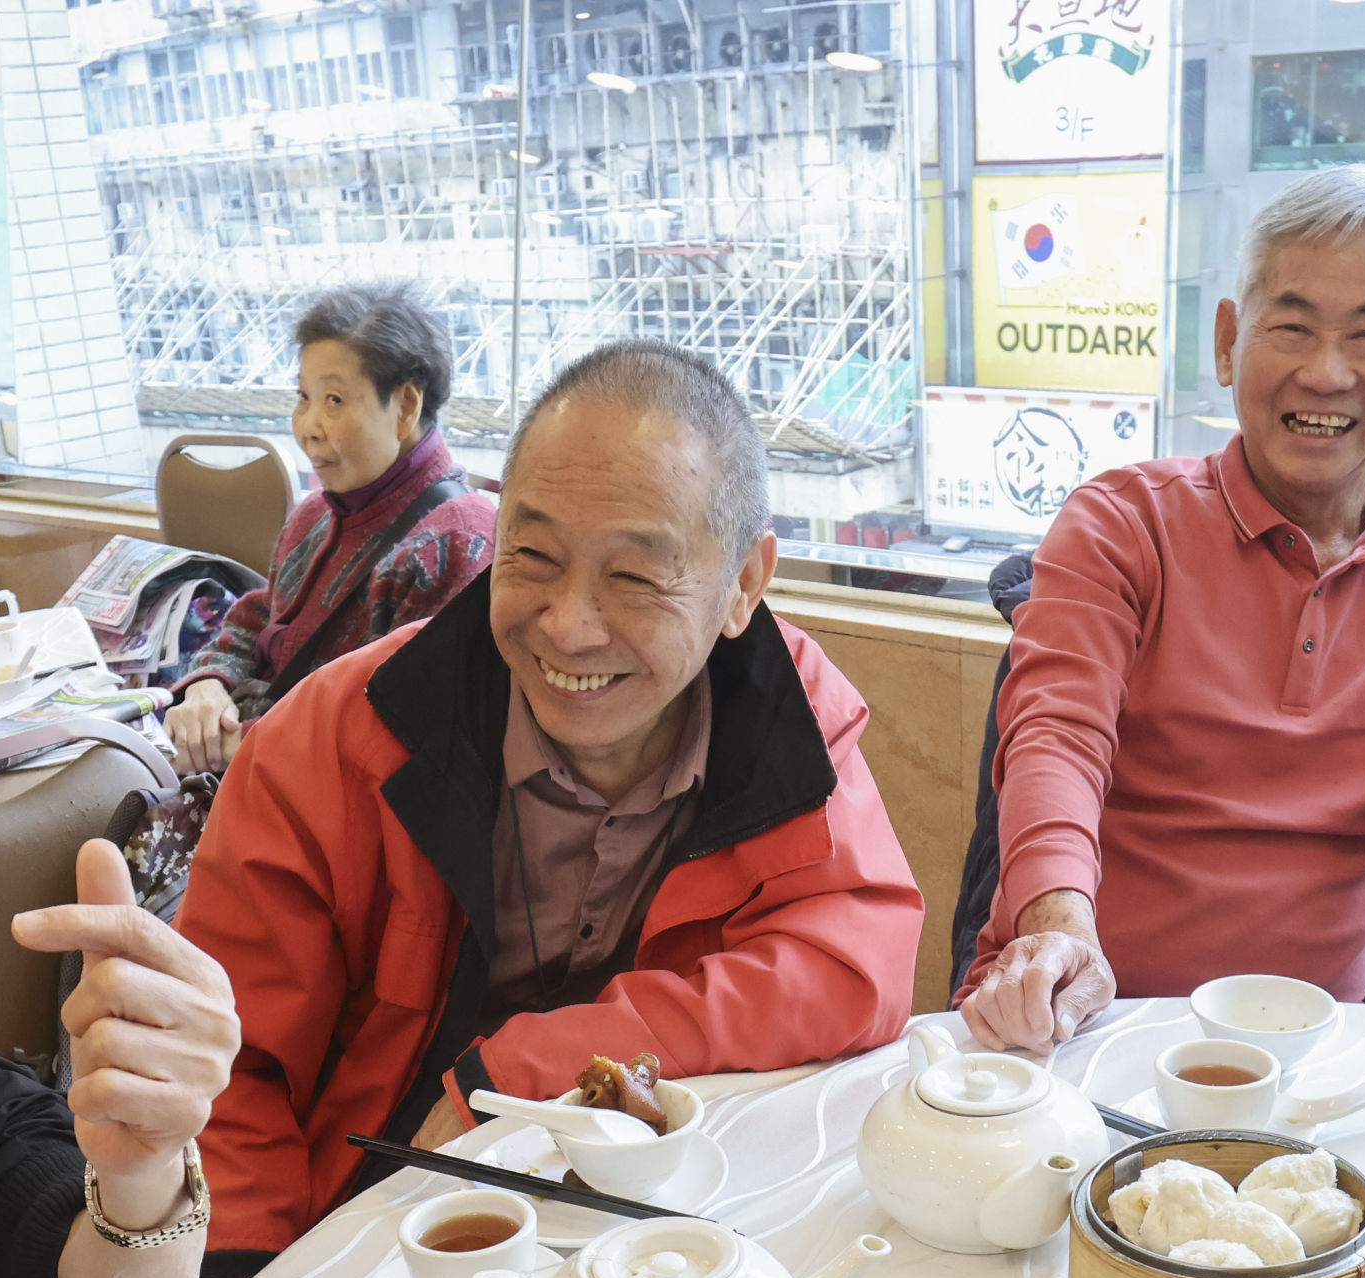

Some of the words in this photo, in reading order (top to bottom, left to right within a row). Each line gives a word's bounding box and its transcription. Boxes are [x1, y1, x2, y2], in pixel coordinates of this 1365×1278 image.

[1055, 106, 1095, 142] 3/F
[1115, 302, 1158, 317] KONG
[997, 321, 1158, 357] OUTDARK
